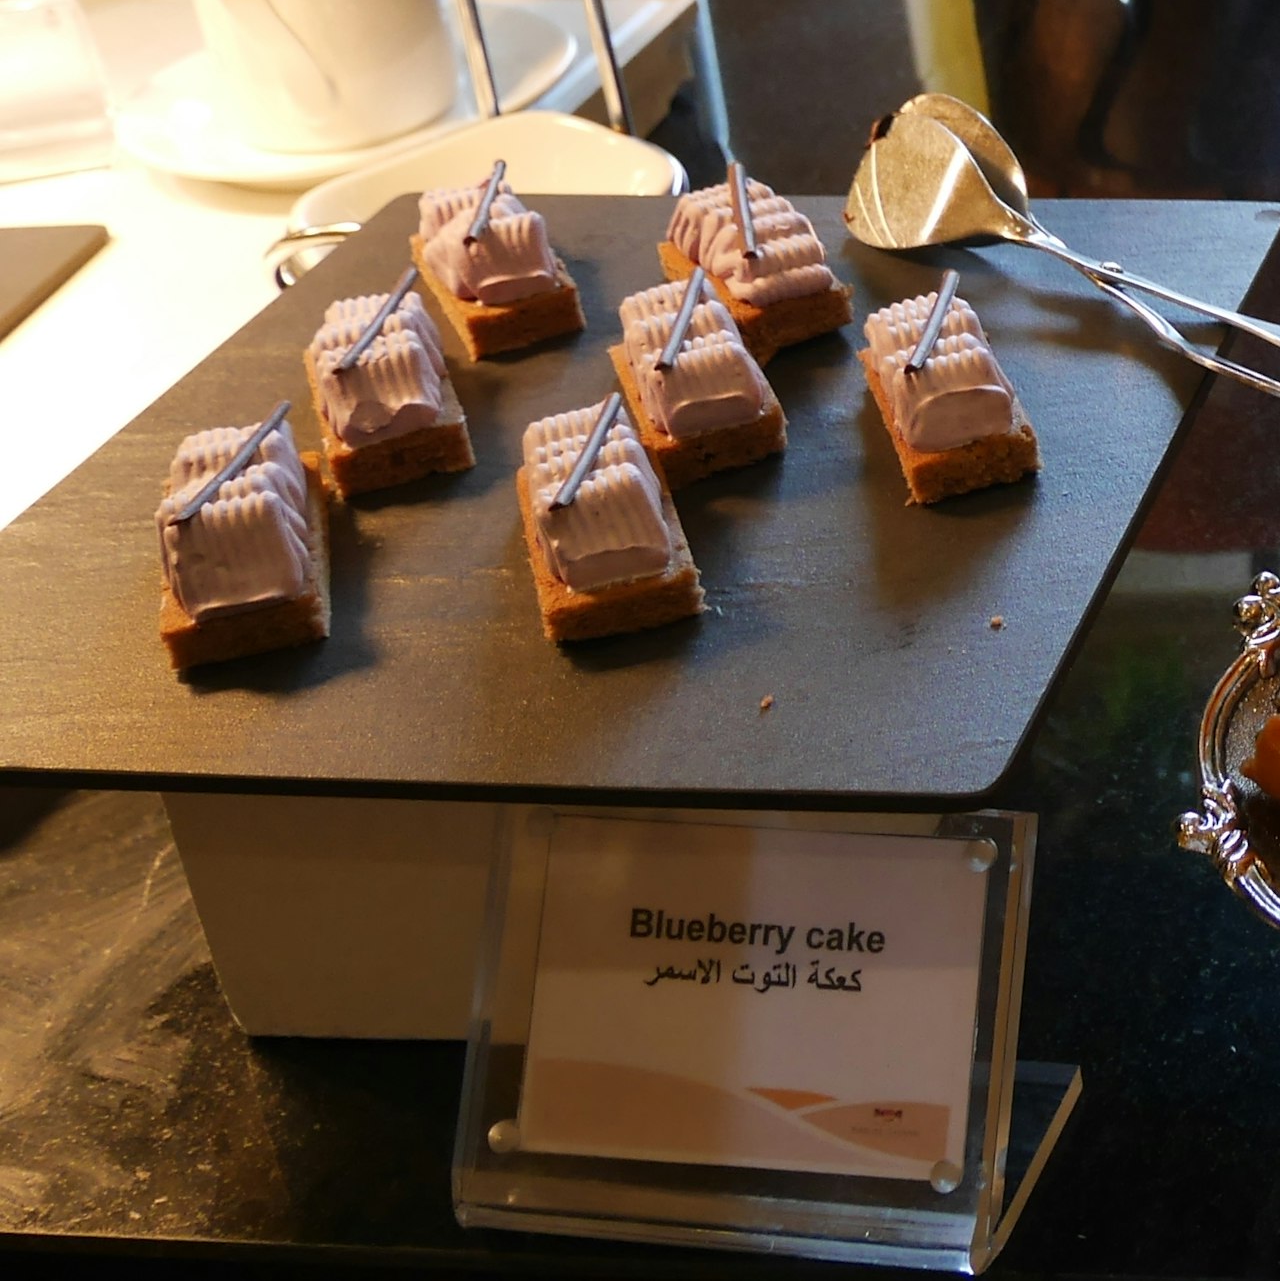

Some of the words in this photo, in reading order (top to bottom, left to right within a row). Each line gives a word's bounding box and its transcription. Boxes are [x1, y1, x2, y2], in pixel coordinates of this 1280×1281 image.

[629, 907, 796, 955] Blueberry
[806, 922, 886, 954] cake
[731, 962, 797, 994] التوت
[806, 959, 863, 993] كعكة
